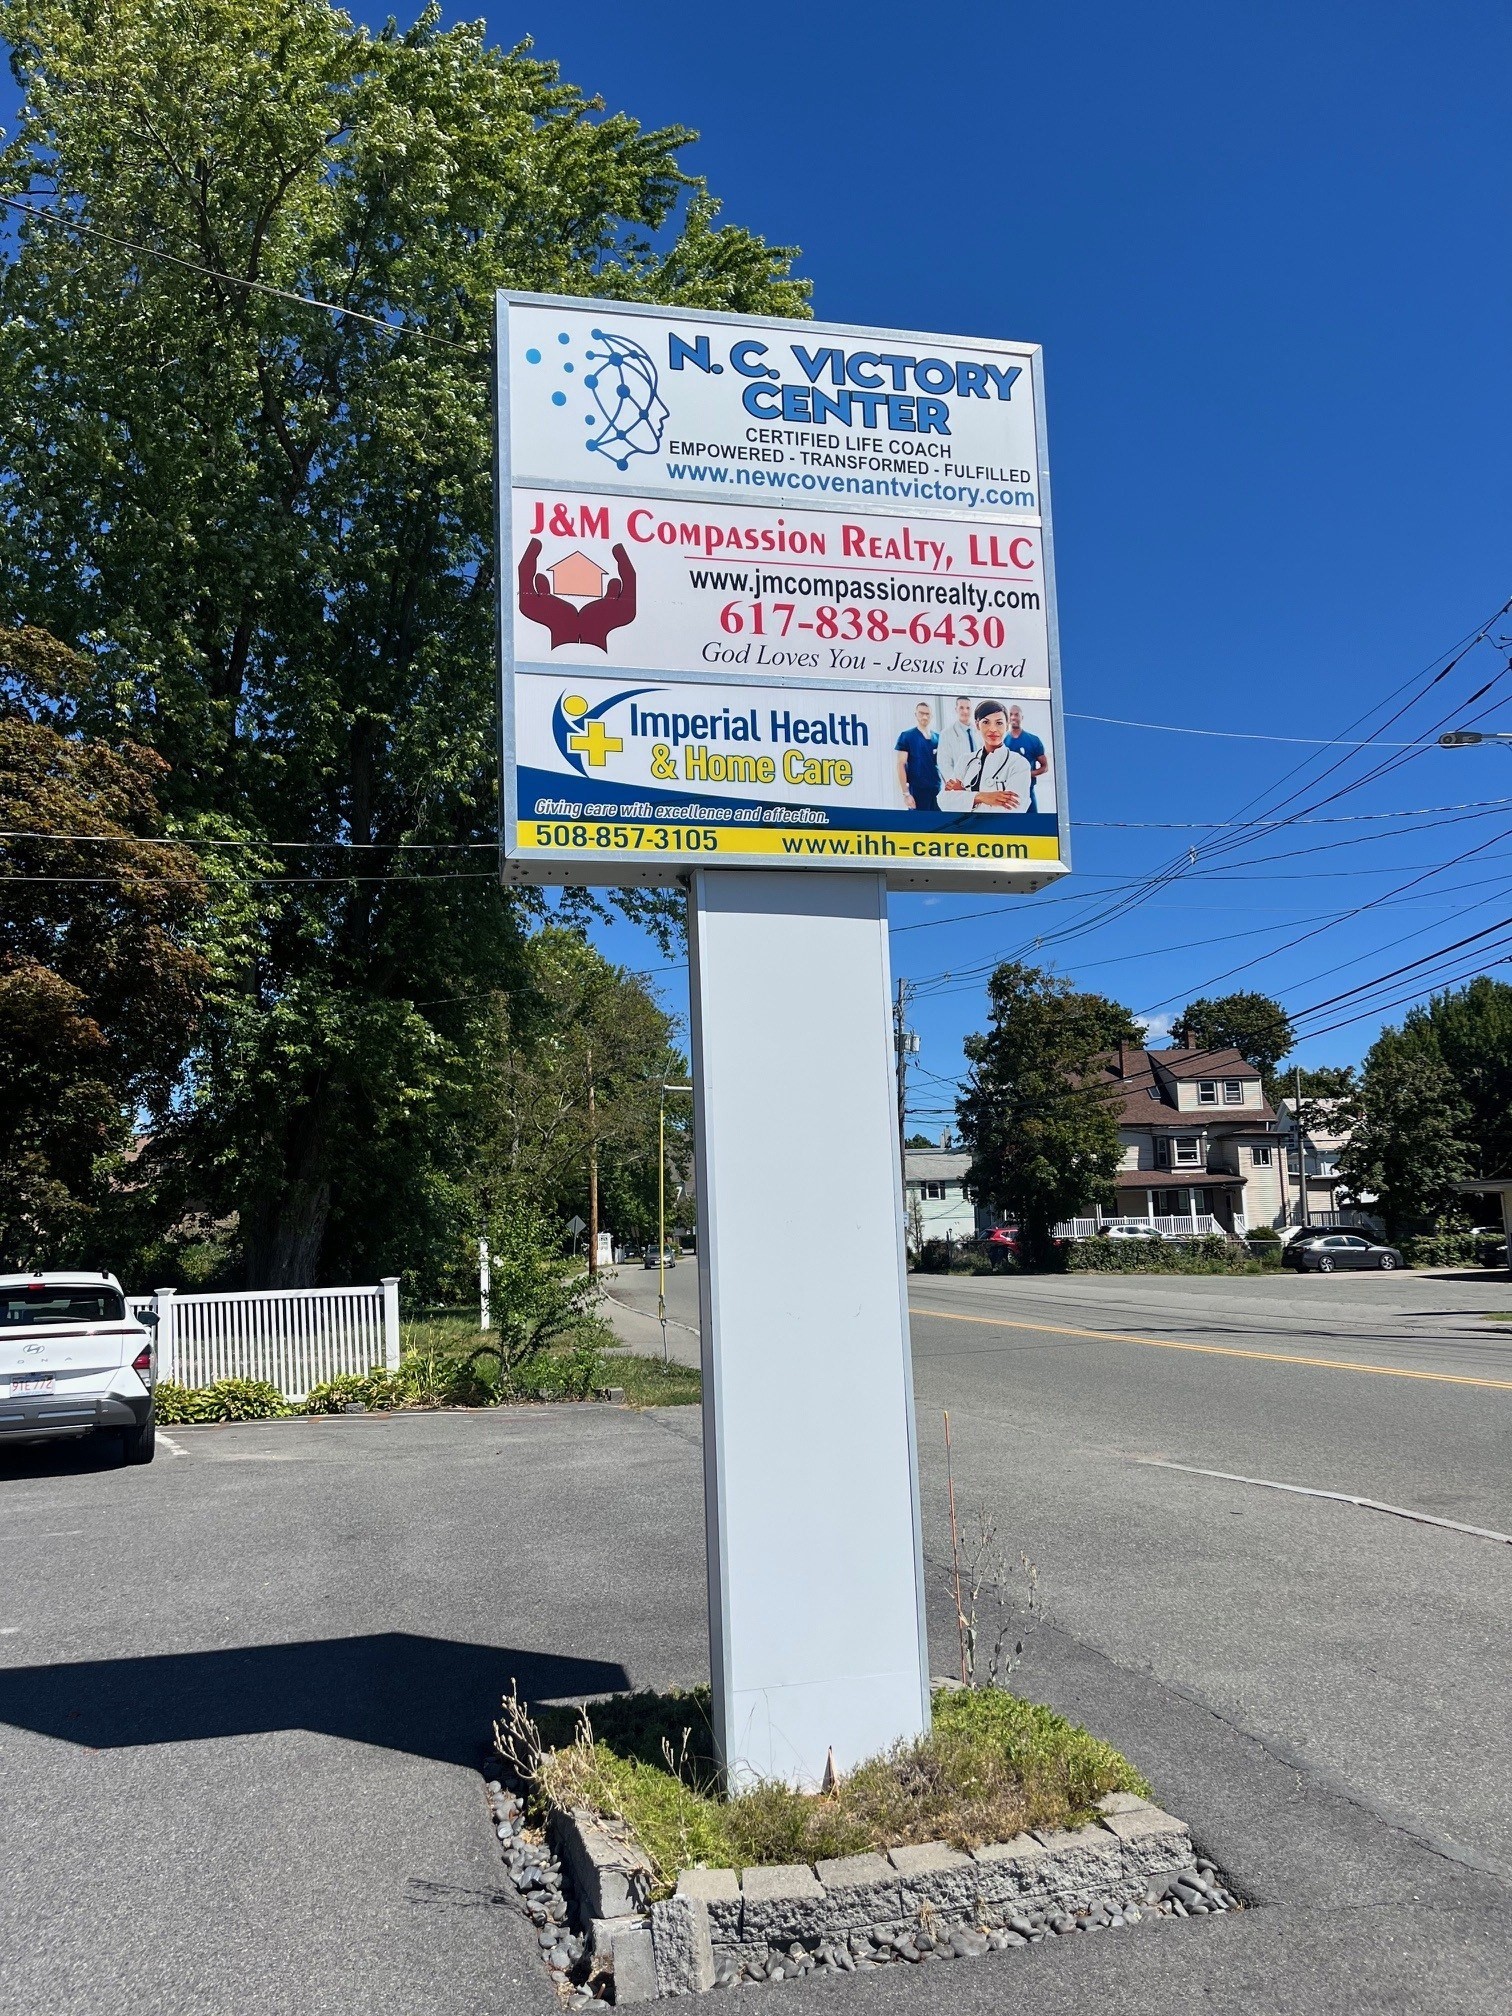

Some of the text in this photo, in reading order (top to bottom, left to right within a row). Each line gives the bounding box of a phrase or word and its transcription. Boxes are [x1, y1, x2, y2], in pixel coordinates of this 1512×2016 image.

[669, 332, 1022, 401] N. C. VICTORY
[742, 382, 951, 435] CENTER
[669, 440, 784, 463] EMPOWERED
[800, 451, 929, 475] TRANSFORMED
[944, 464, 1031, 483] FULFILLED
[746, 428, 951, 458] CERTIFIED LIFE COACH
[666, 463, 1035, 507] www.newcovenantvictory.com
[530, 502, 610, 540] J&M
[969, 534, 1035, 569] LLC
[690, 569, 1040, 612] www.jmcompassionrealty.com
[720, 600, 1005, 648] 617-838-6430
[702, 641, 751, 664] God
[755, 644, 820, 668] Loves
[829, 648, 866, 669] You
[887, 652, 945, 674] Jesus
[952, 656, 968, 675] is
[975, 656, 1027, 678] Lord
[630, 703, 869, 746] Imperial Health
[650, 743, 852, 786] & Home Care
[535, 799, 829, 823] Giving care with excellence and affection.
[536, 824, 718, 851] 508-857-3105
[782, 834, 1028, 859] www.ihh-care.com
